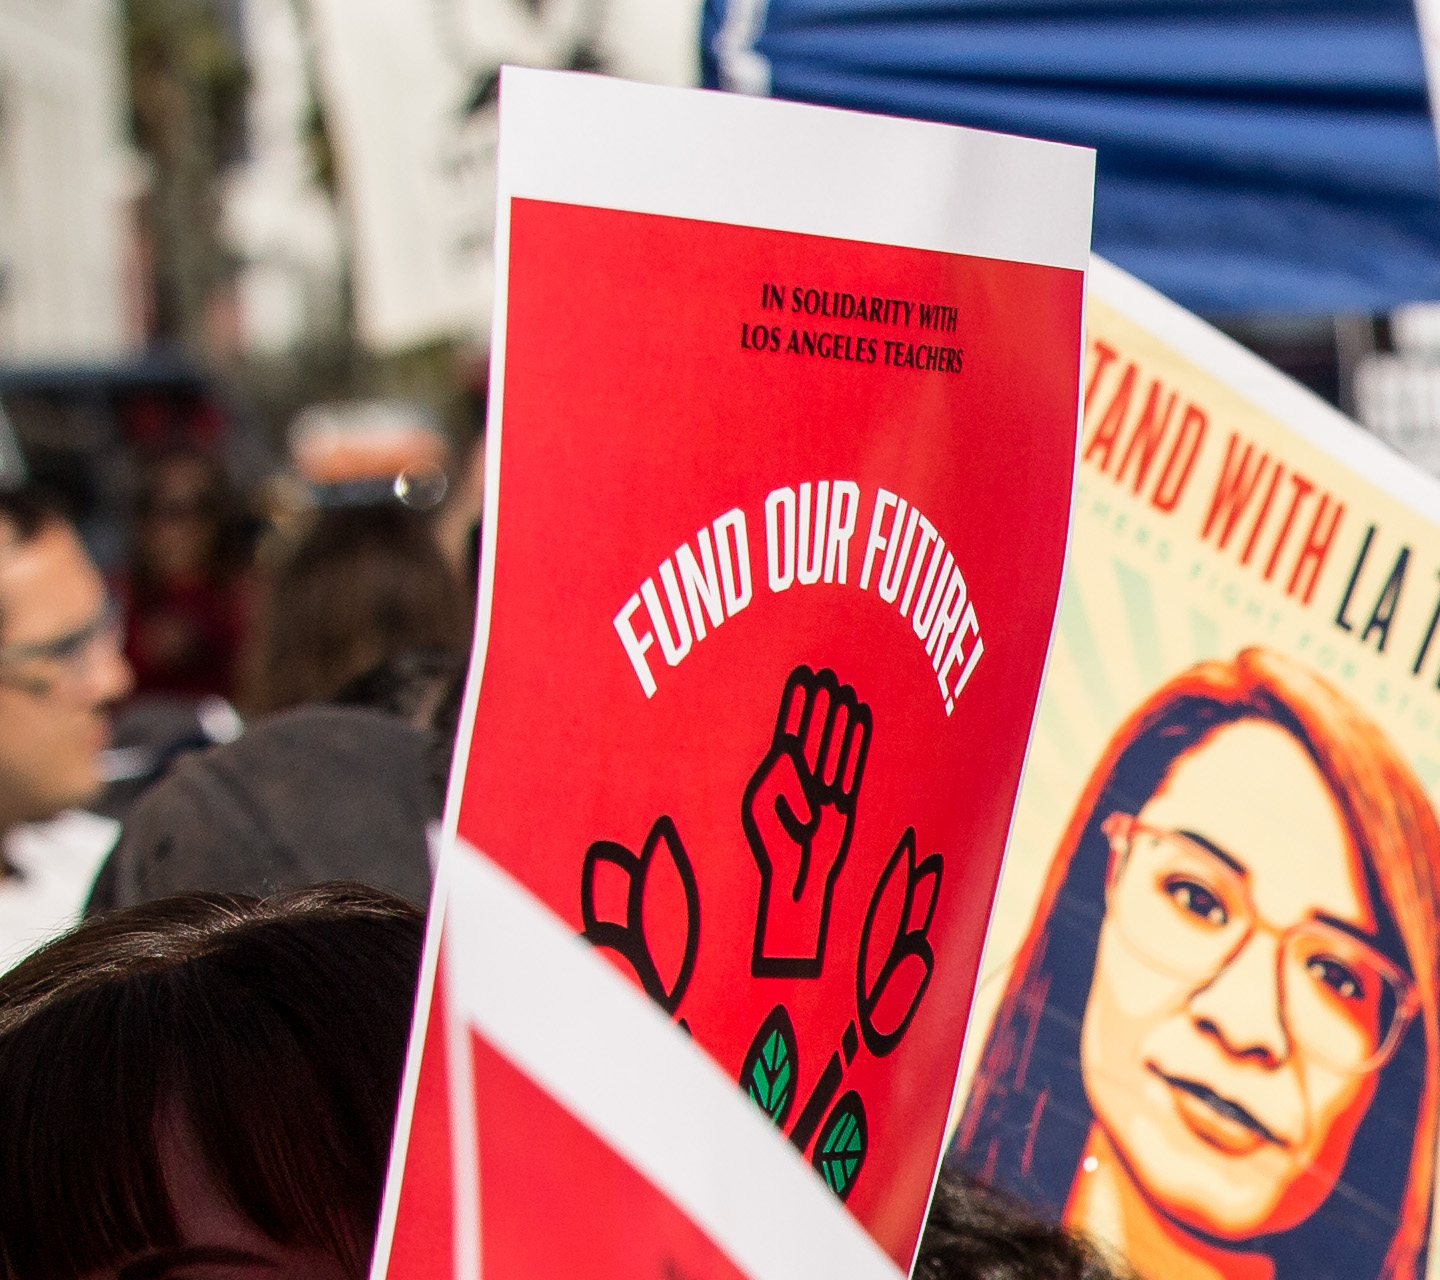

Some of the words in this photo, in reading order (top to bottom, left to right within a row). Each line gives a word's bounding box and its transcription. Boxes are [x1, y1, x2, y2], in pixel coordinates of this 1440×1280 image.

[741, 322, 782, 353] LOS
[786, 328, 878, 365] ANGELES
[883, 339, 964, 374] TEACHERS
[761, 283, 786, 311] IN
[791, 287, 916, 327] SOLIDARITY
[919, 302, 959, 332] WITH
[612, 507, 753, 700] FUND
[765, 479, 861, 593] OUR
[859, 487, 985, 717] FUTURE!
[1199, 430, 1346, 607] WITH
[1332, 521, 1413, 655] LA
